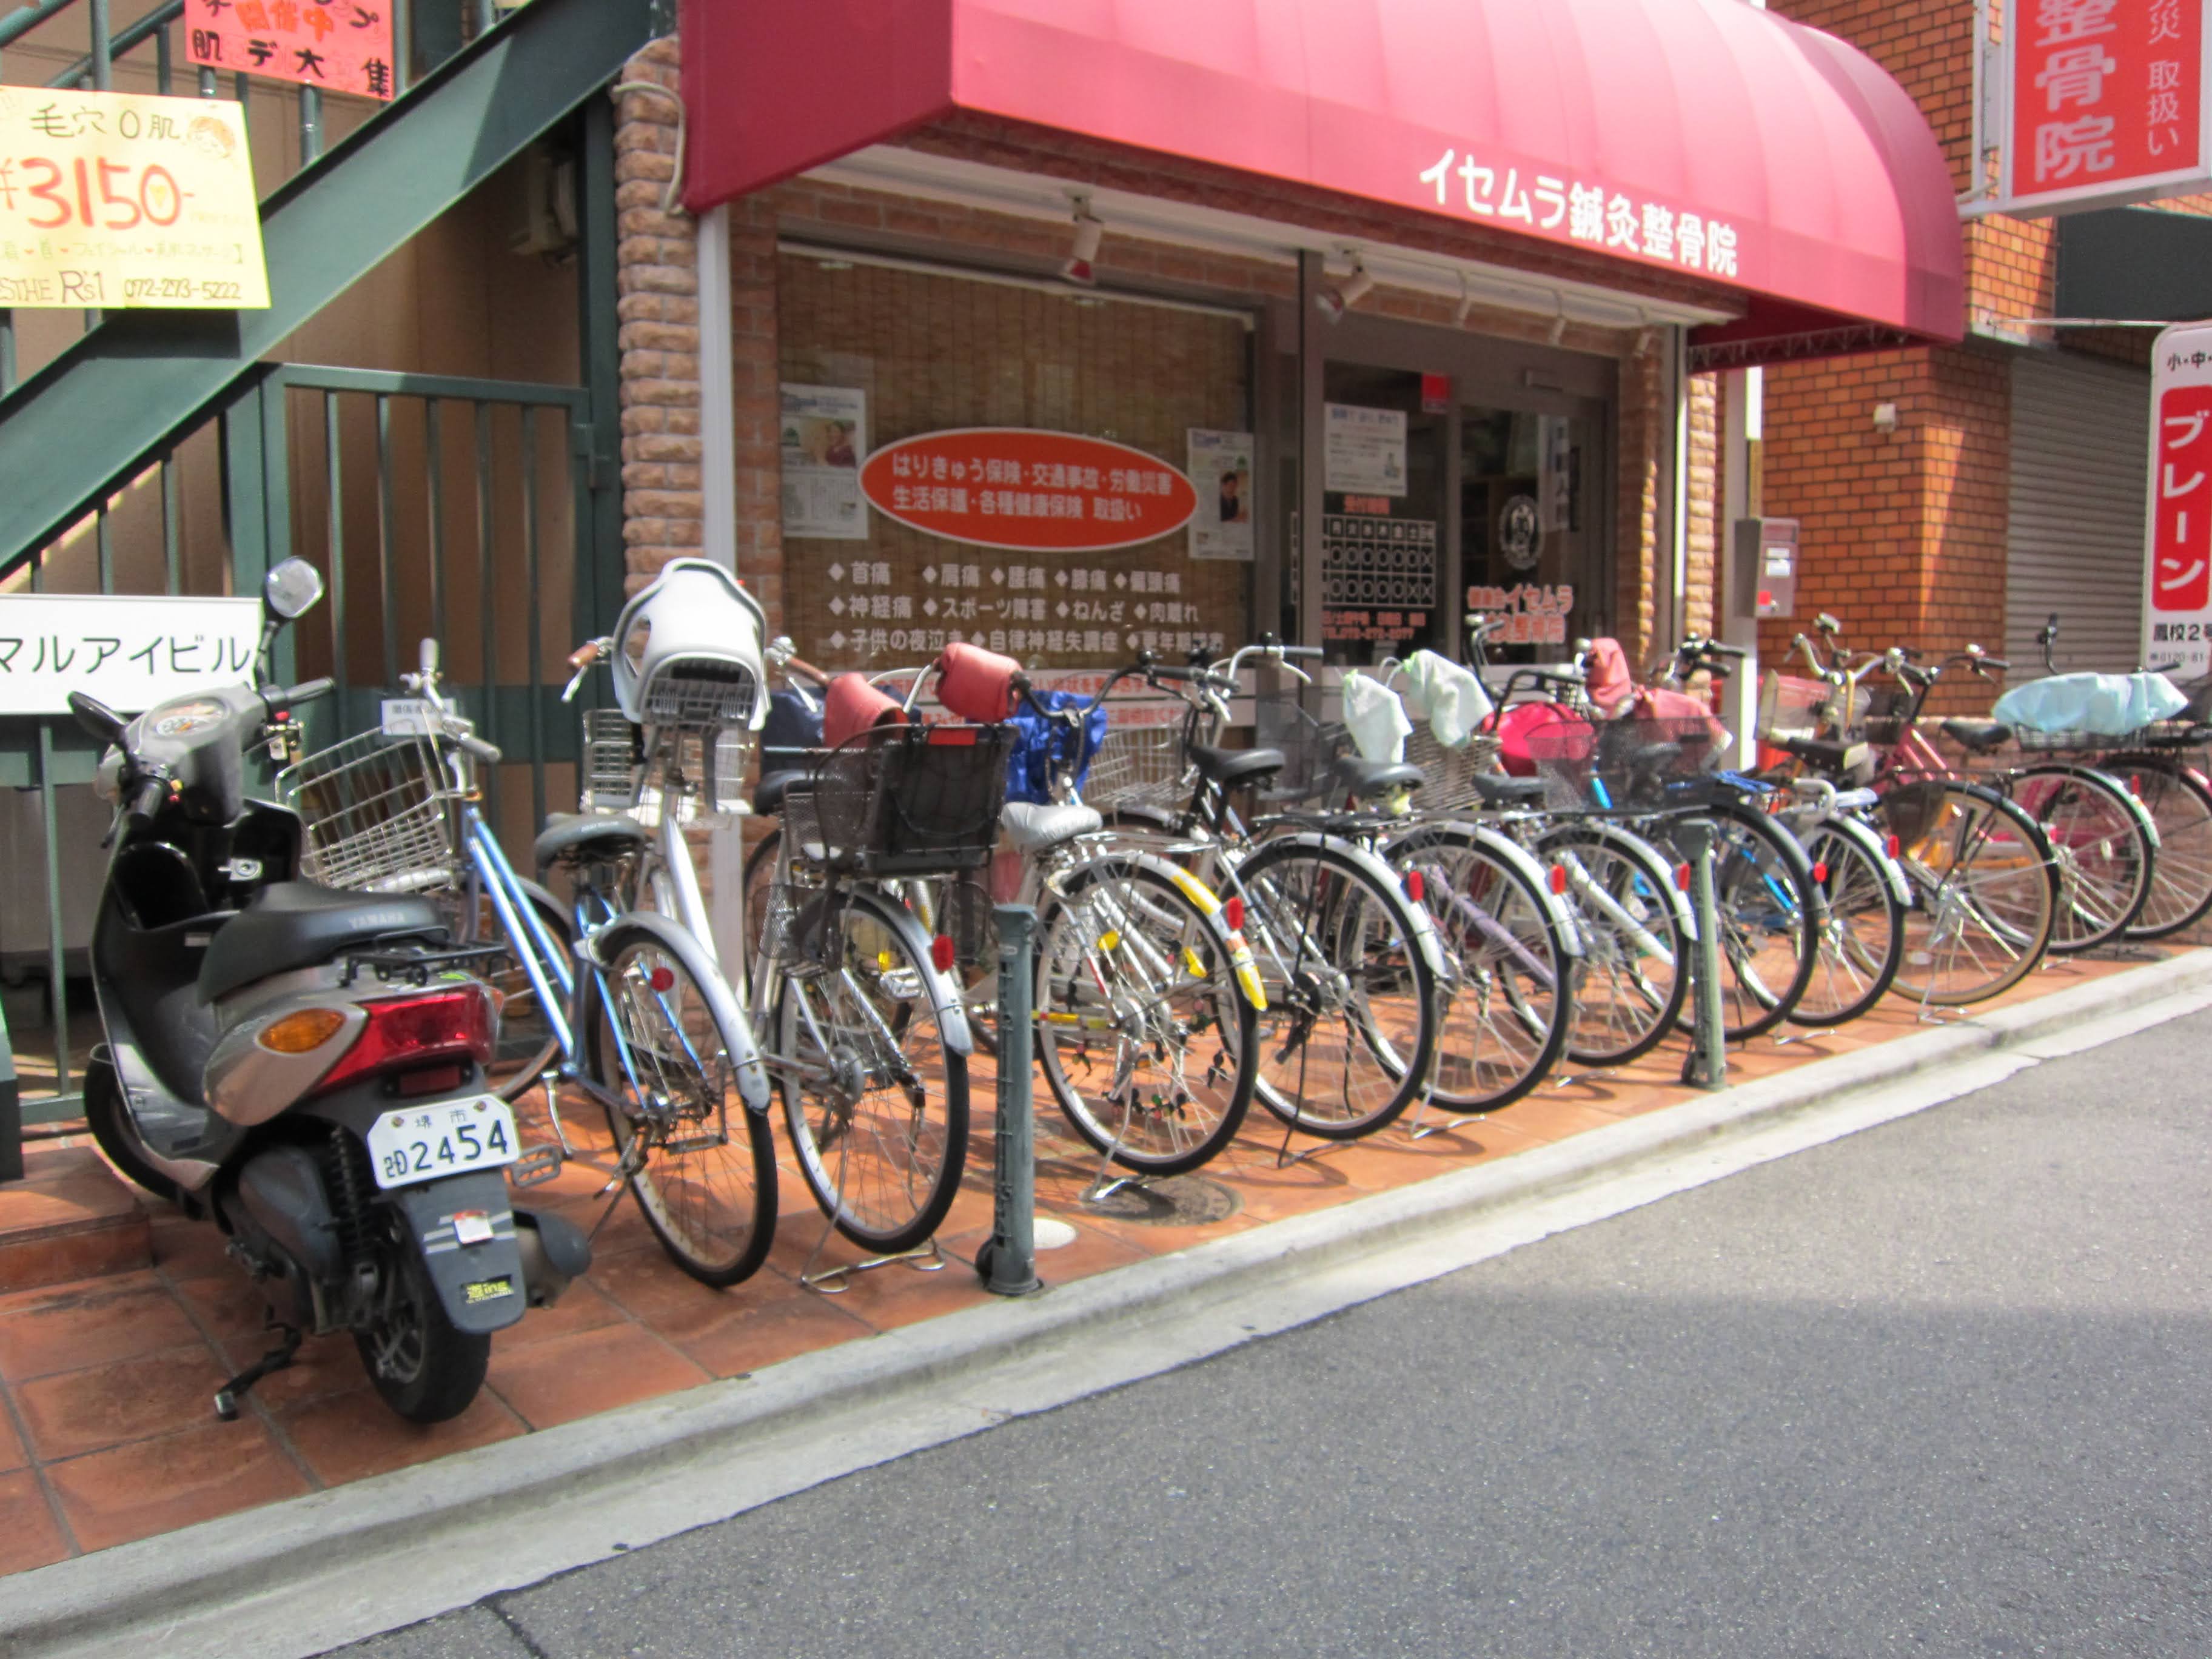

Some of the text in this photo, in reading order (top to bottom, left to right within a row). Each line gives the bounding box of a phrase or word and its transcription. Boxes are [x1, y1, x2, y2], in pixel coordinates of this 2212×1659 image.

[2147, 59, 2180, 156] 取扱い
[1419, 148, 1738, 278] イセムラ鍼灸整骨院
[123, 278, 242, 301] 072-273-5222
[2160, 410, 2210, 591] ブレーン
[851, 561, 891, 585] 首痛
[941, 563, 980, 588] 肩痛
[849, 595, 912, 618] 神経痛
[0, 635, 250, 675] マルアイビル
[990, 629, 1119, 653] 自律神経失調症
